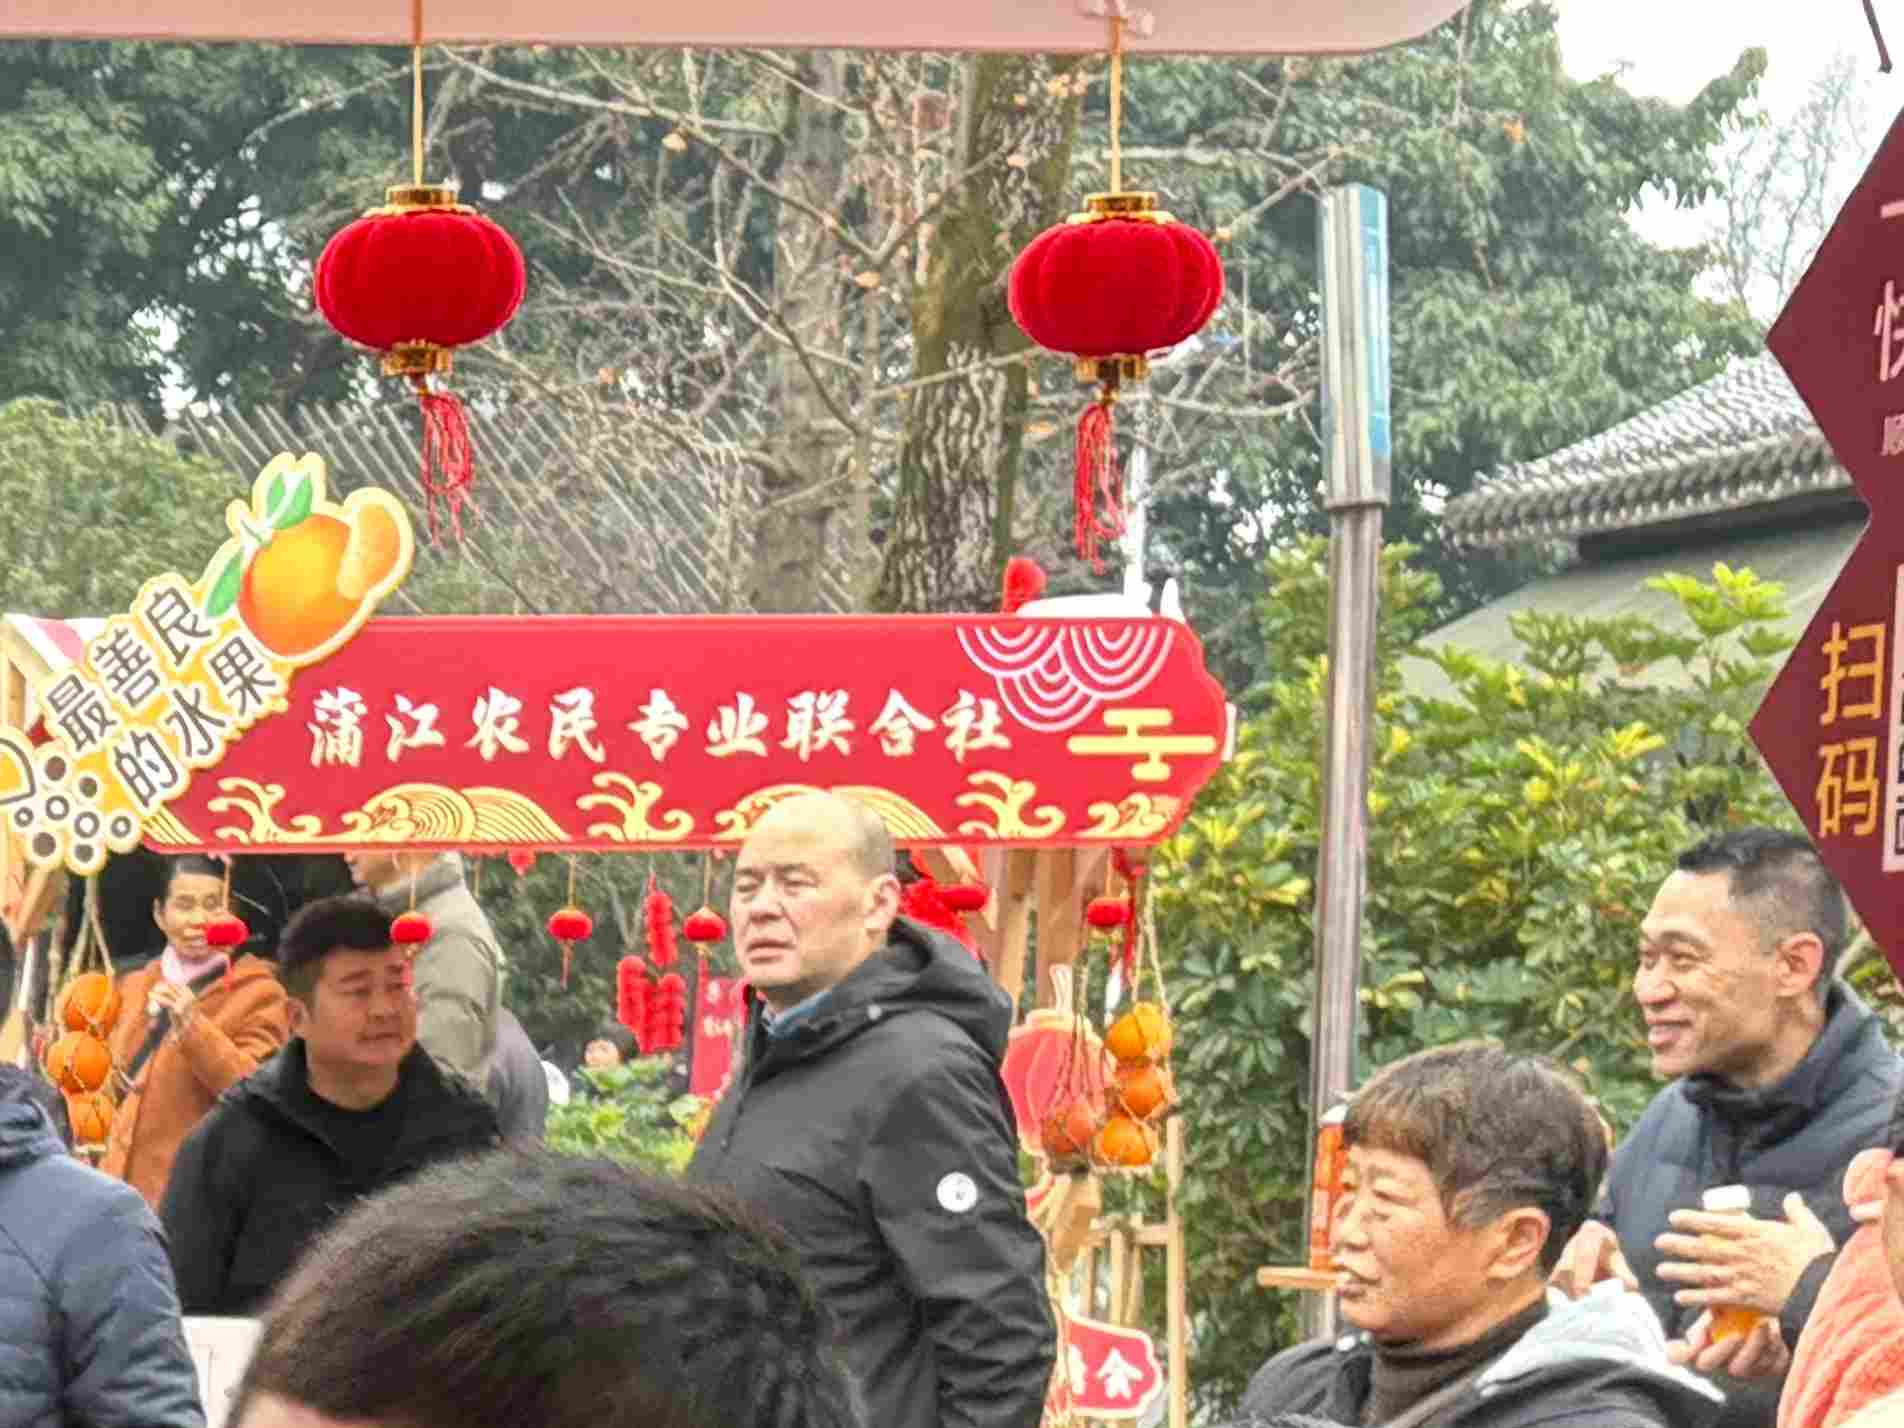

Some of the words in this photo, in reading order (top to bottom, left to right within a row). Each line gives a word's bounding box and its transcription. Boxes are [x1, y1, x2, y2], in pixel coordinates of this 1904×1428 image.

[47, 587, 213, 752] 最善良
[114, 636, 277, 808] 的水果
[308, 686, 1014, 769] 蒲江农民专业联合社
